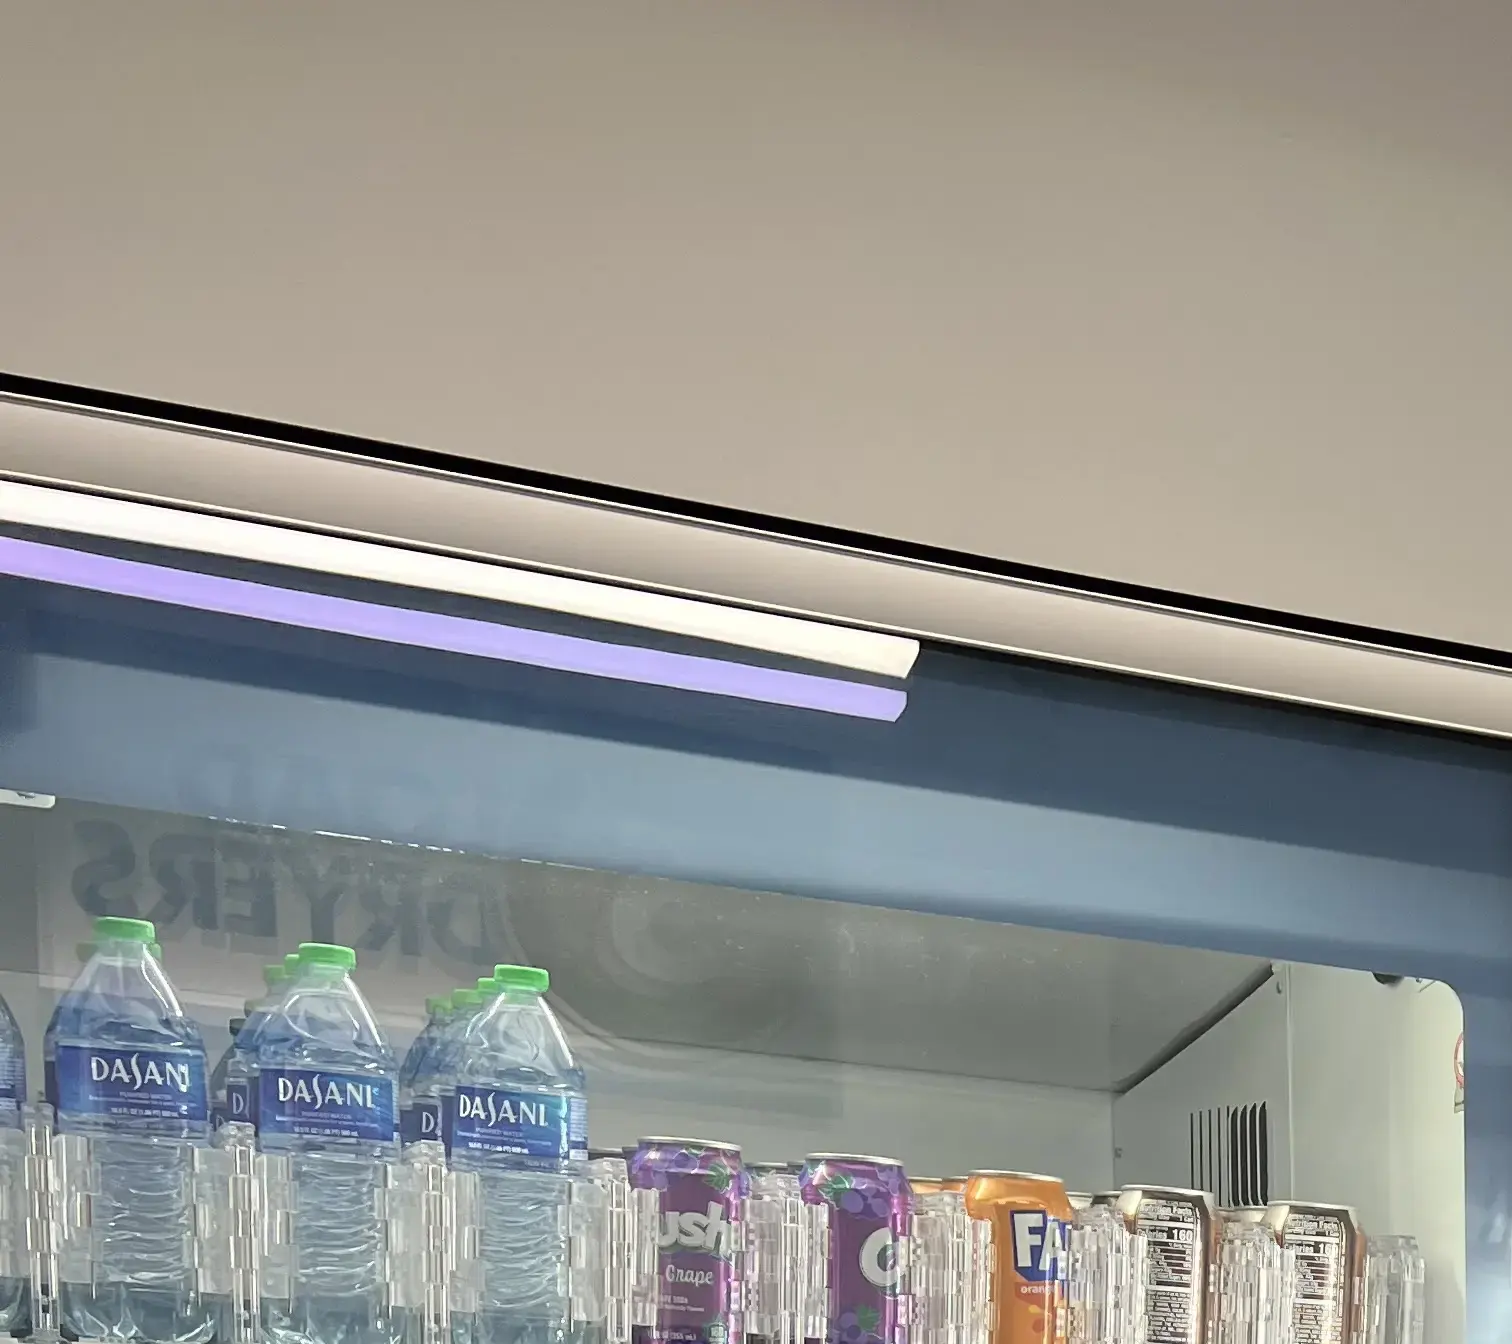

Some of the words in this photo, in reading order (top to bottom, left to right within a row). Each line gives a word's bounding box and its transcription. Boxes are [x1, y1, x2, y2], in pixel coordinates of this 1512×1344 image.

[90, 1052, 190, 1092] DASANI
[278, 1074, 376, 1109] DASANI
[459, 1092, 548, 1127] DASANI
[1172, 1229, 1194, 1242] 160
[665, 1264, 715, 1286] Grape
